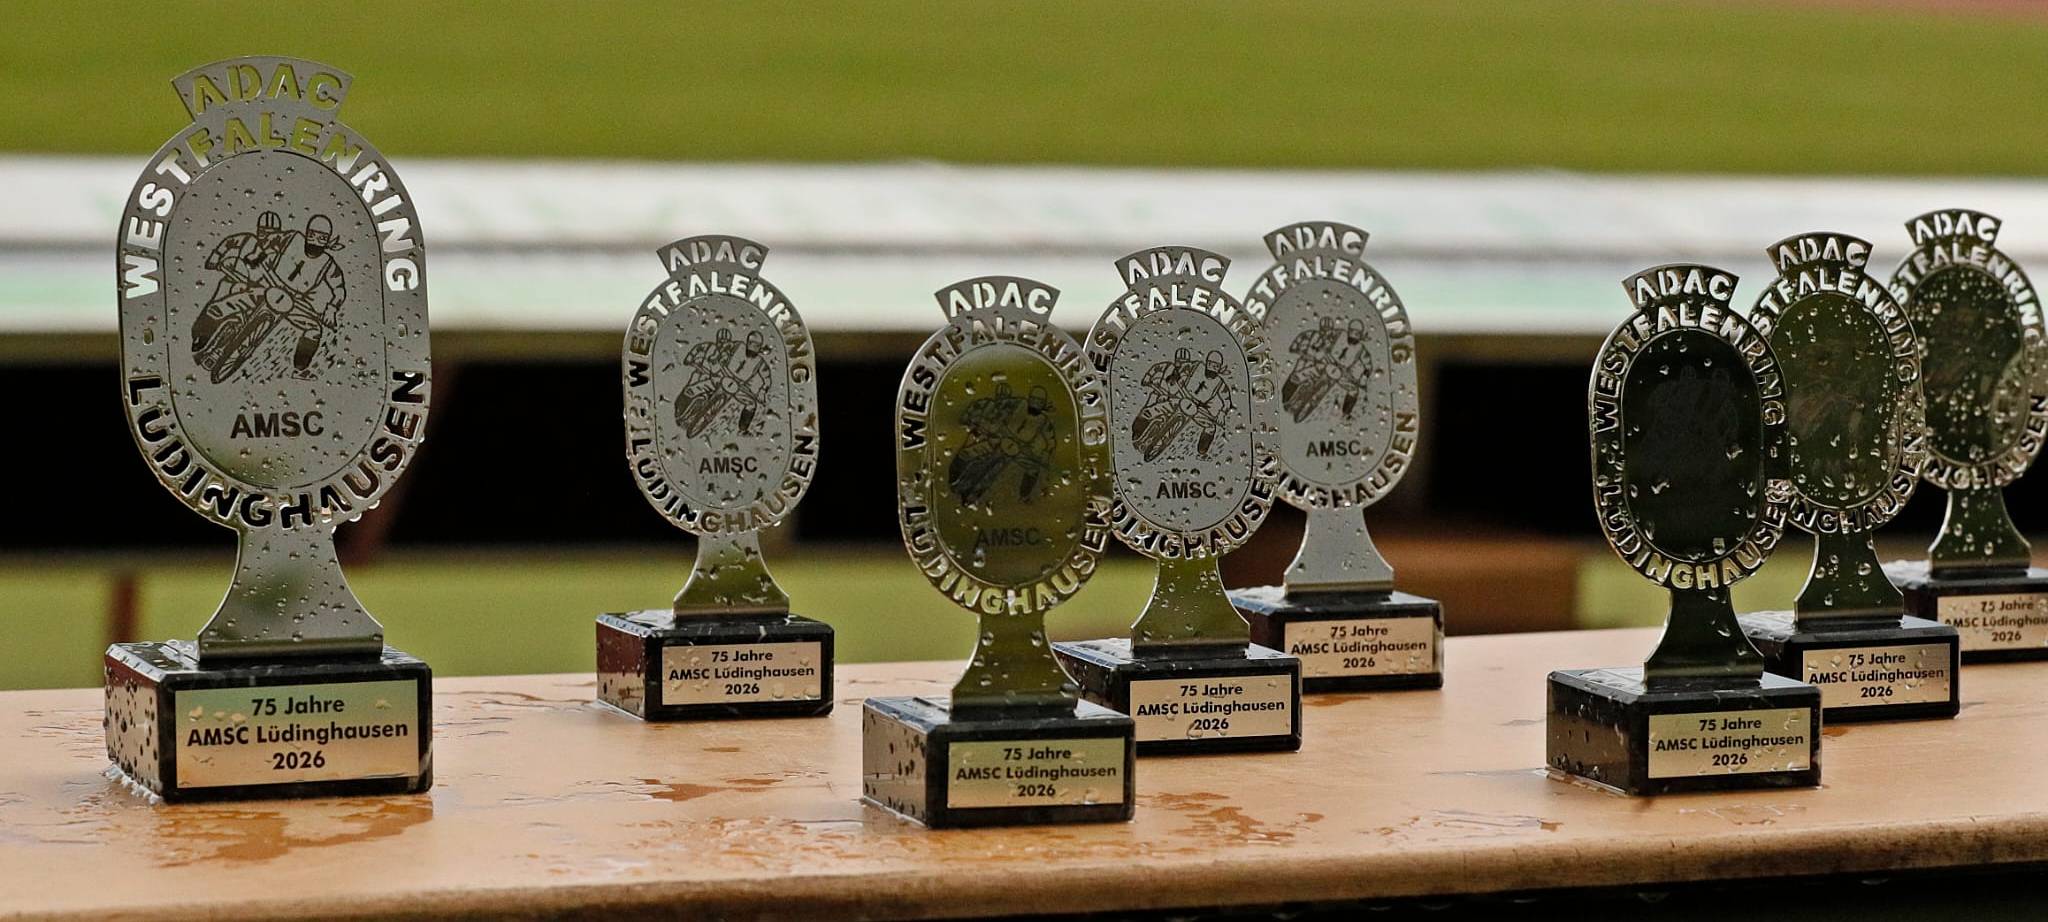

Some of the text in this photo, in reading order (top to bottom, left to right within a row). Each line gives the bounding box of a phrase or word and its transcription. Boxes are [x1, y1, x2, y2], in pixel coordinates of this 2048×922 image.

[192, 64, 342, 114] ADAC
[126, 112, 420, 299] WESTFALENRING
[1915, 213, 1998, 244] ADAC
[1275, 226, 1362, 256] ADAC
[670, 241, 761, 272] ADAC
[1779, 238, 1865, 270] ADAC
[1128, 252, 1222, 285] ADAC
[1636, 269, 1731, 304] ADAC
[950, 282, 1051, 317] ADAC
[1246, 256, 1411, 364] STFALENRING
[629, 271, 812, 388] WESTFALENRING
[1751, 270, 1918, 382] STFALENRING
[1088, 285, 1275, 401] ESTFALENRING
[1594, 303, 1785, 432] WESTFALENRING
[902, 317, 1107, 450] WESTFALENRING
[230, 412, 325, 439] AMSC
[128, 371, 425, 529] LÜDINGHAUSEN
[1306, 441, 1362, 457] AMSC
[699, 457, 758, 474] AMSC
[1278, 412, 1418, 508] INGHAUSEN
[1156, 482, 1217, 499] AMSC
[1112, 454, 1280, 559] DINGHAUSEN
[975, 528, 1041, 548] AMSC
[1981, 600, 2034, 612] 75 Jahre
[1982, 615, 2048, 628] Lüdinghau
[1330, 625, 1388, 638] 75 Jahre
[1991, 631, 2022, 642] 2026
[712, 650, 773, 663] 75 Jahre
[1291, 641, 1427, 655] AMSC Lüdinghausen
[1343, 657, 1375, 669] 2026
[1849, 653, 1906, 666] 75 Jahre
[669, 666, 814, 681] AMSC Lüdinghausen
[1809, 669, 1944, 684] AMSC Lüdinghausen
[725, 683, 760, 695] 2026
[1180, 684, 1243, 697] 75 Jahre
[1861, 686, 1893, 698] 2026
[252, 696, 345, 716] 75 Jahre
[1137, 701, 1285, 716] AMSC Lüdinghausen
[1194, 718, 1229, 731] 2026
[1699, 718, 1761, 731] 75 Jahre
[187, 722, 408, 747] AMSC Lüdinghausen
[1656, 735, 1803, 751] AMSC Lüdinghausen
[272, 751, 325, 770] 2026
[1003, 747, 1071, 760] 75 Jahre
[1712, 754, 1748, 766] 2026
[956, 766, 1117, 780] AMSC Lüdinghausen
[1017, 784, 1056, 797] 2026
